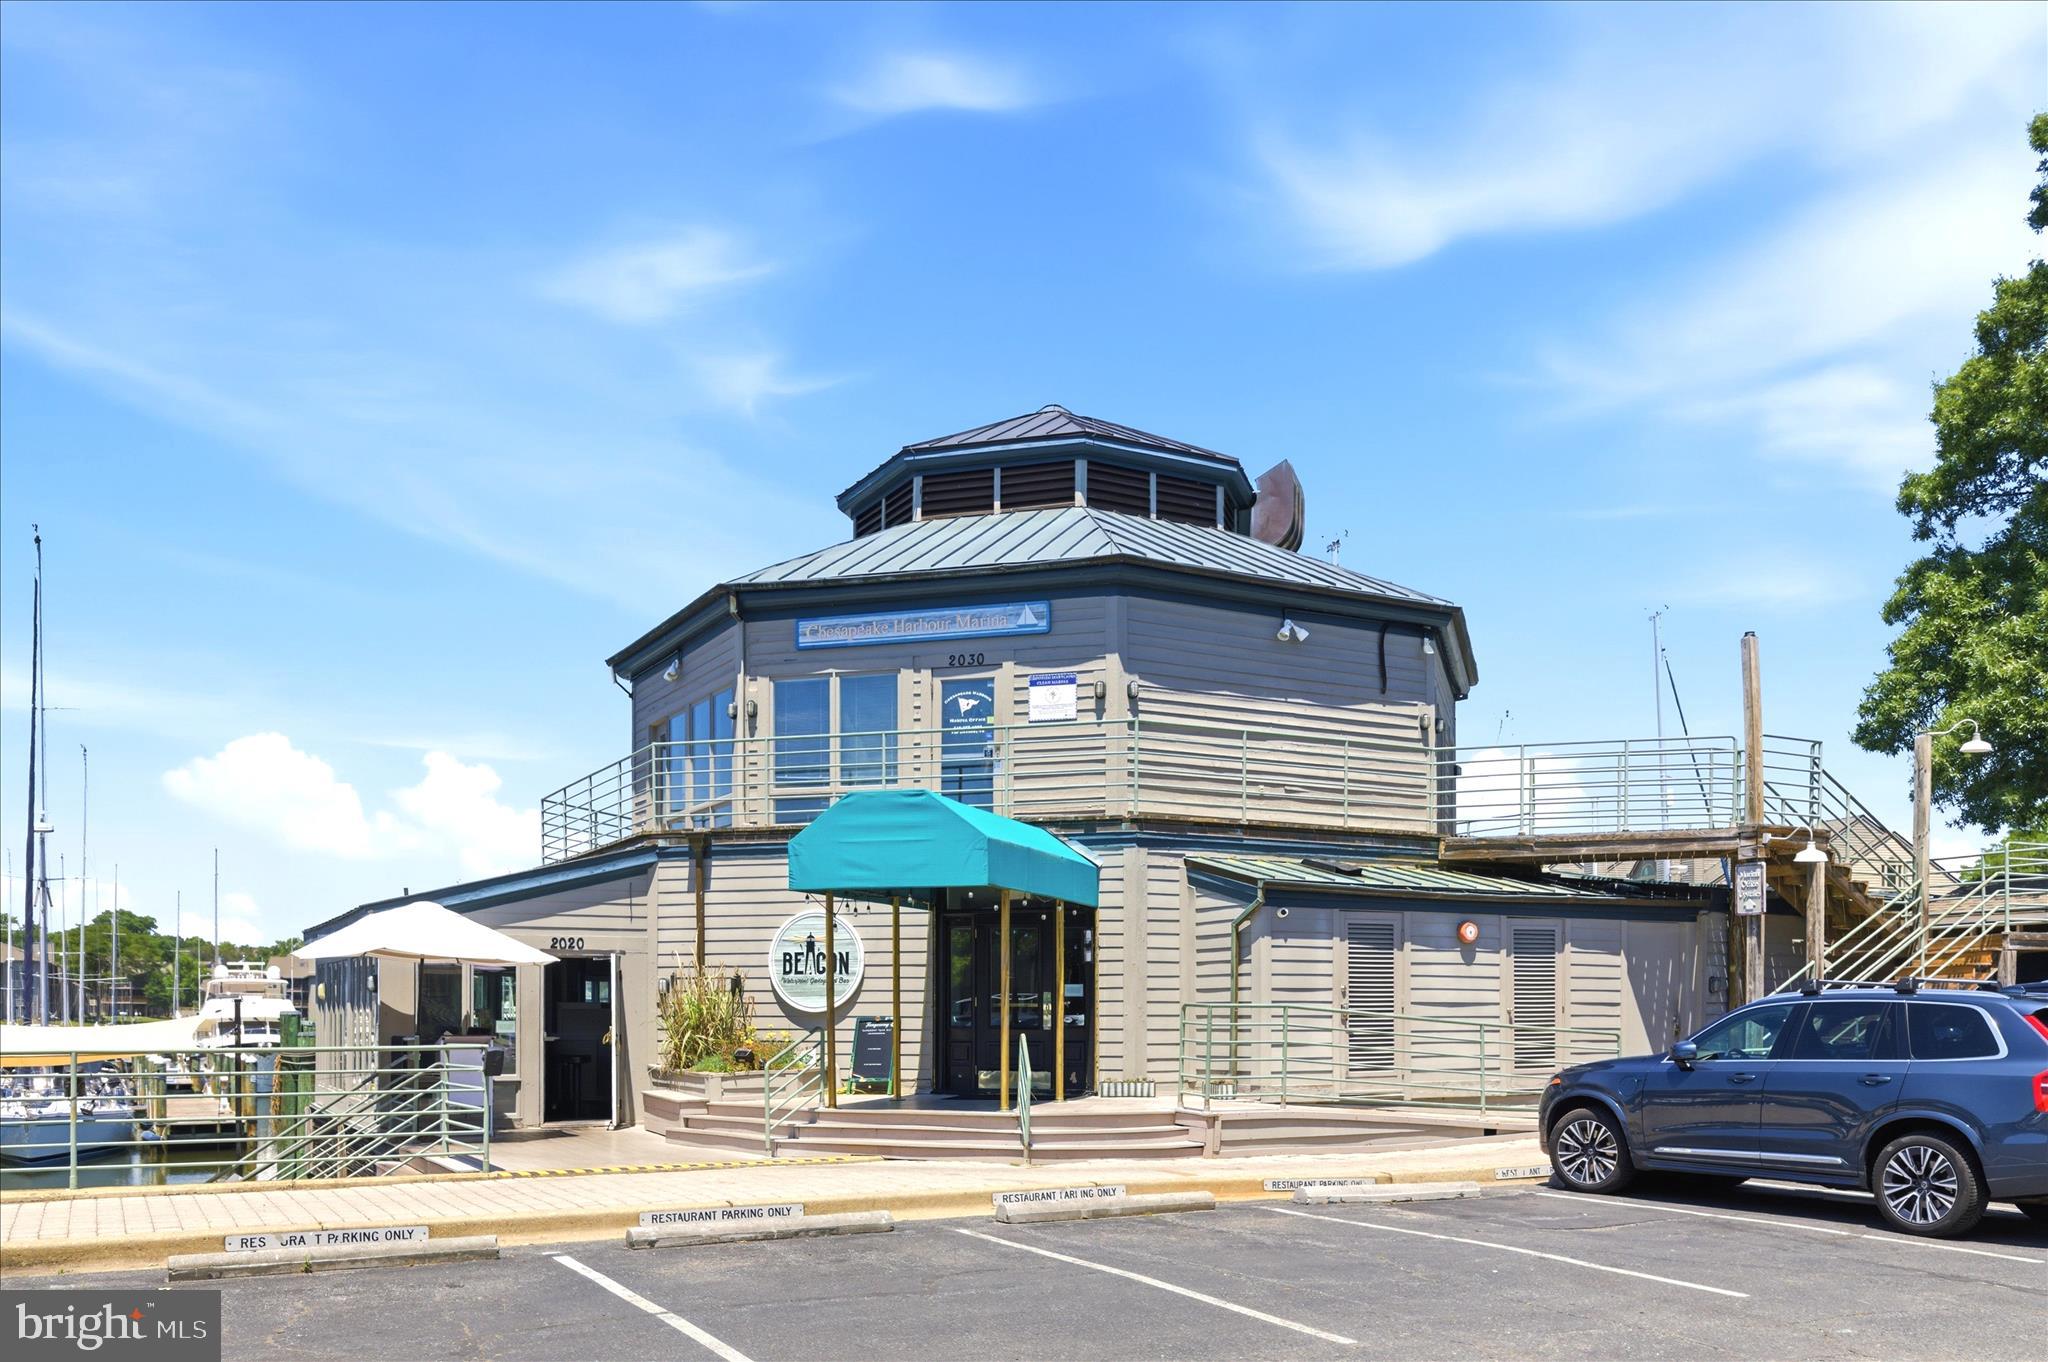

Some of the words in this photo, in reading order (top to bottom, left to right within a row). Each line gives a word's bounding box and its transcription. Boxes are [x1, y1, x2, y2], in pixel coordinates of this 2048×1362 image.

[806, 620, 888, 640] Chesapeake
[894, 617, 949, 634] Harbour
[956, 614, 1008, 630] Marina
[948, 653, 984, 666] 2030
[550, 937, 584, 950] 2020
[1098, 1188, 1116, 1197] ONLY
[652, 1211, 717, 1224] RESTAURANT
[722, 1208, 764, 1220] PARKING
[768, 1207, 792, 1217] ONLY
[385, 1229, 414, 1240] ONLY
